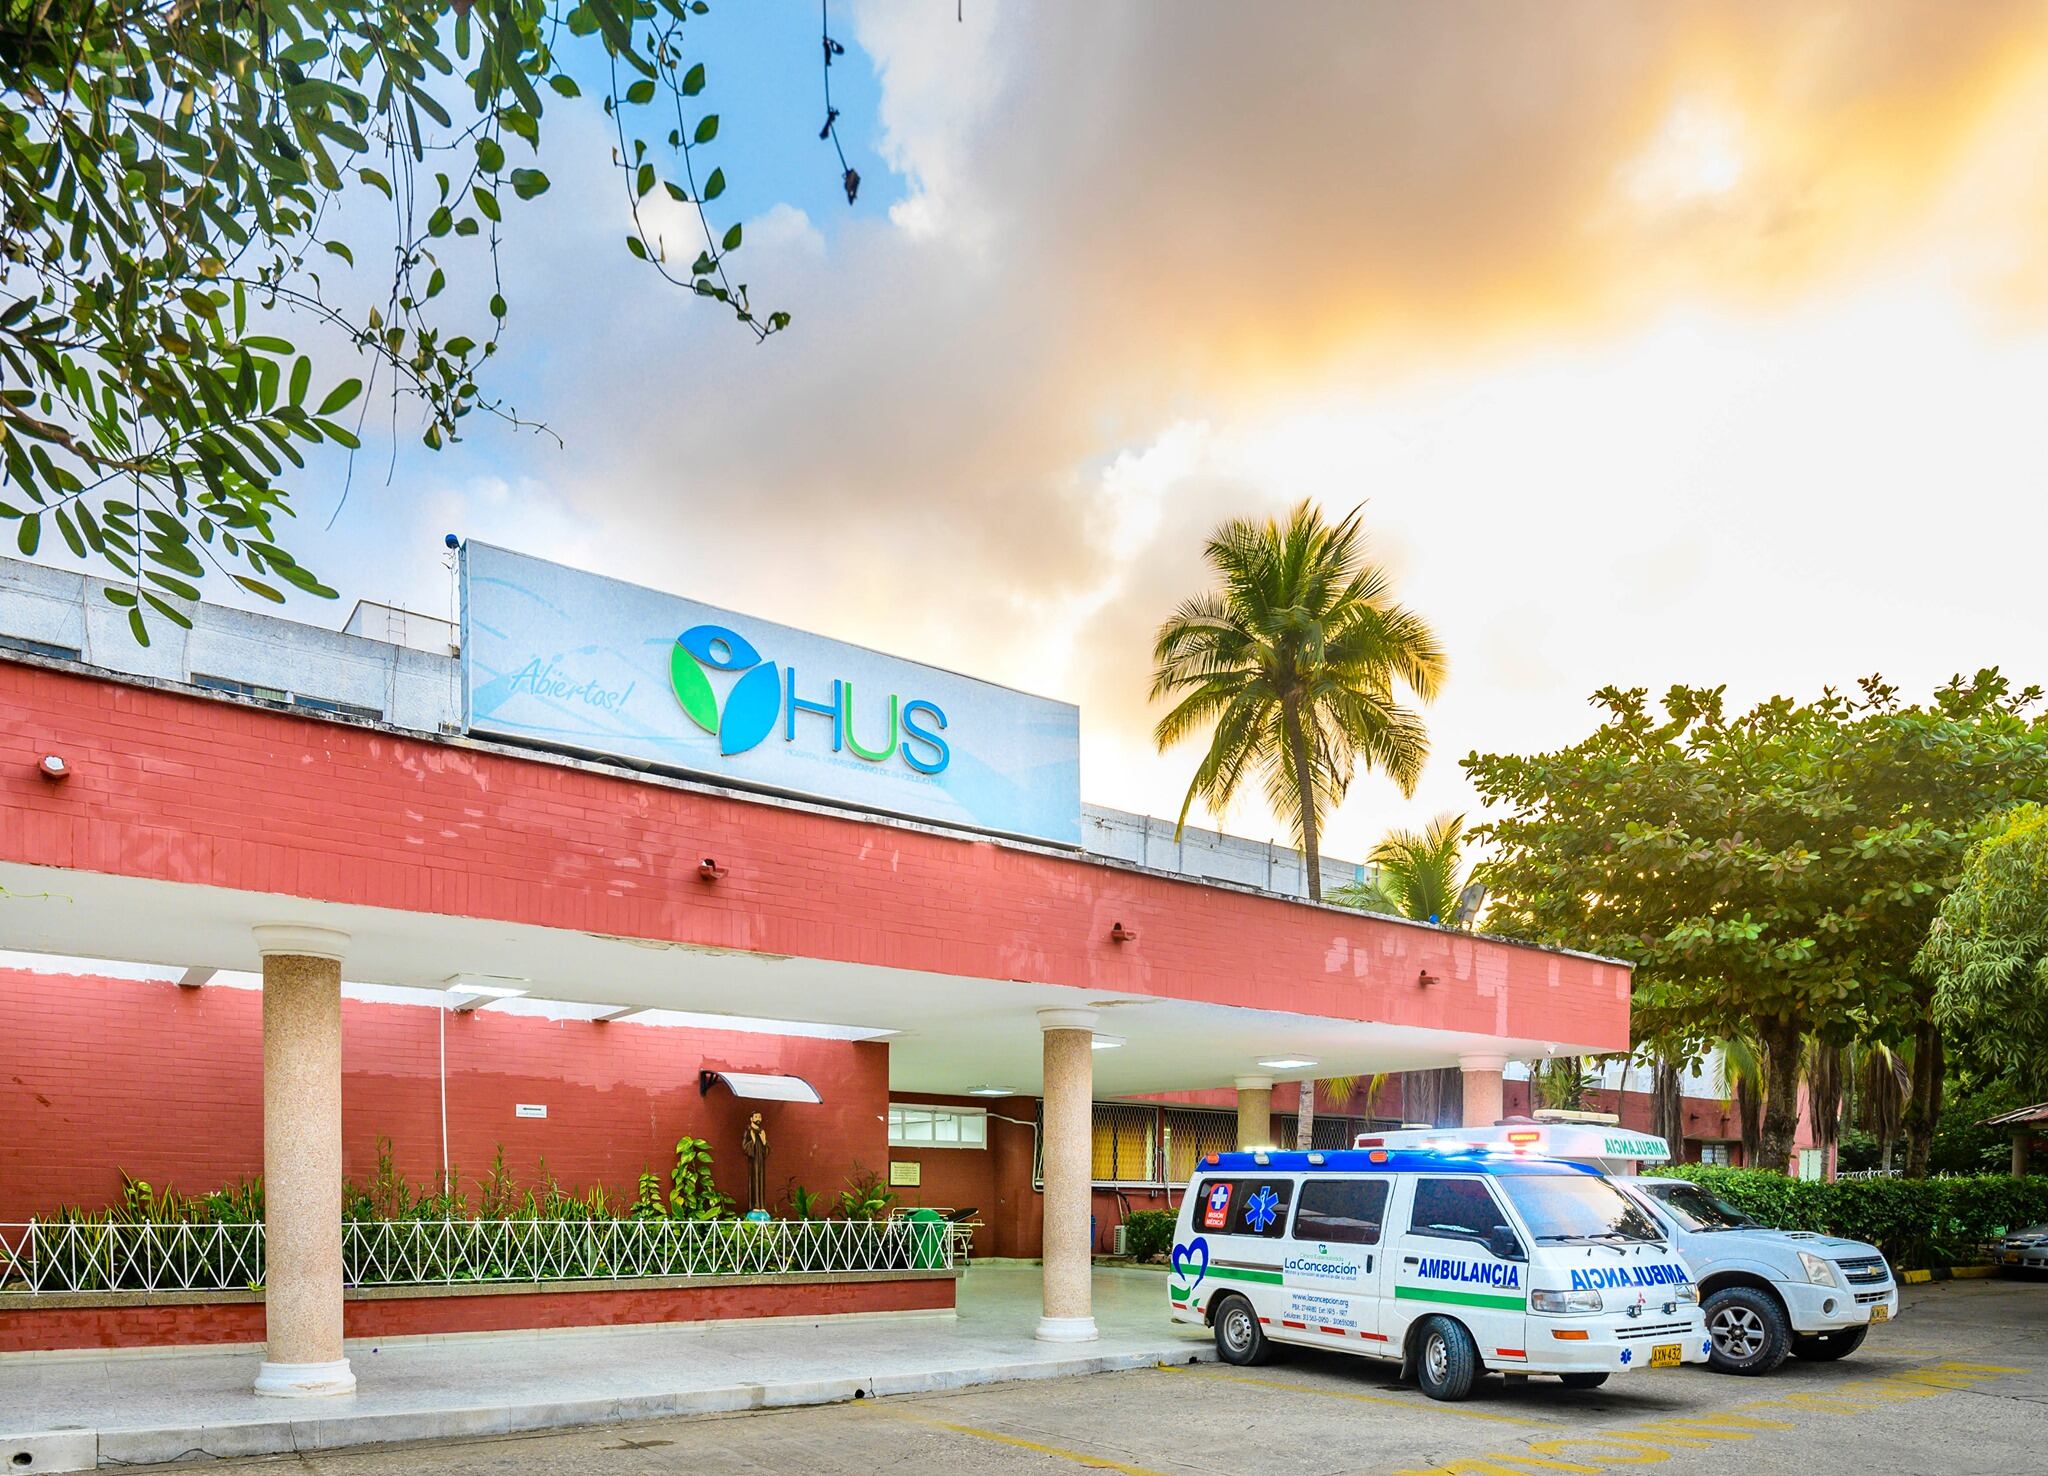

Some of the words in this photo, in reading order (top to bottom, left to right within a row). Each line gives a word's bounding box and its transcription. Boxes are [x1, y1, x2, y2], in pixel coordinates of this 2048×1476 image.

[784, 666, 950, 775] HUS
[1417, 1257, 1519, 1287] AMBULANCIA
[1291, 1293, 1349, 1308] www.laconcepcion.org
